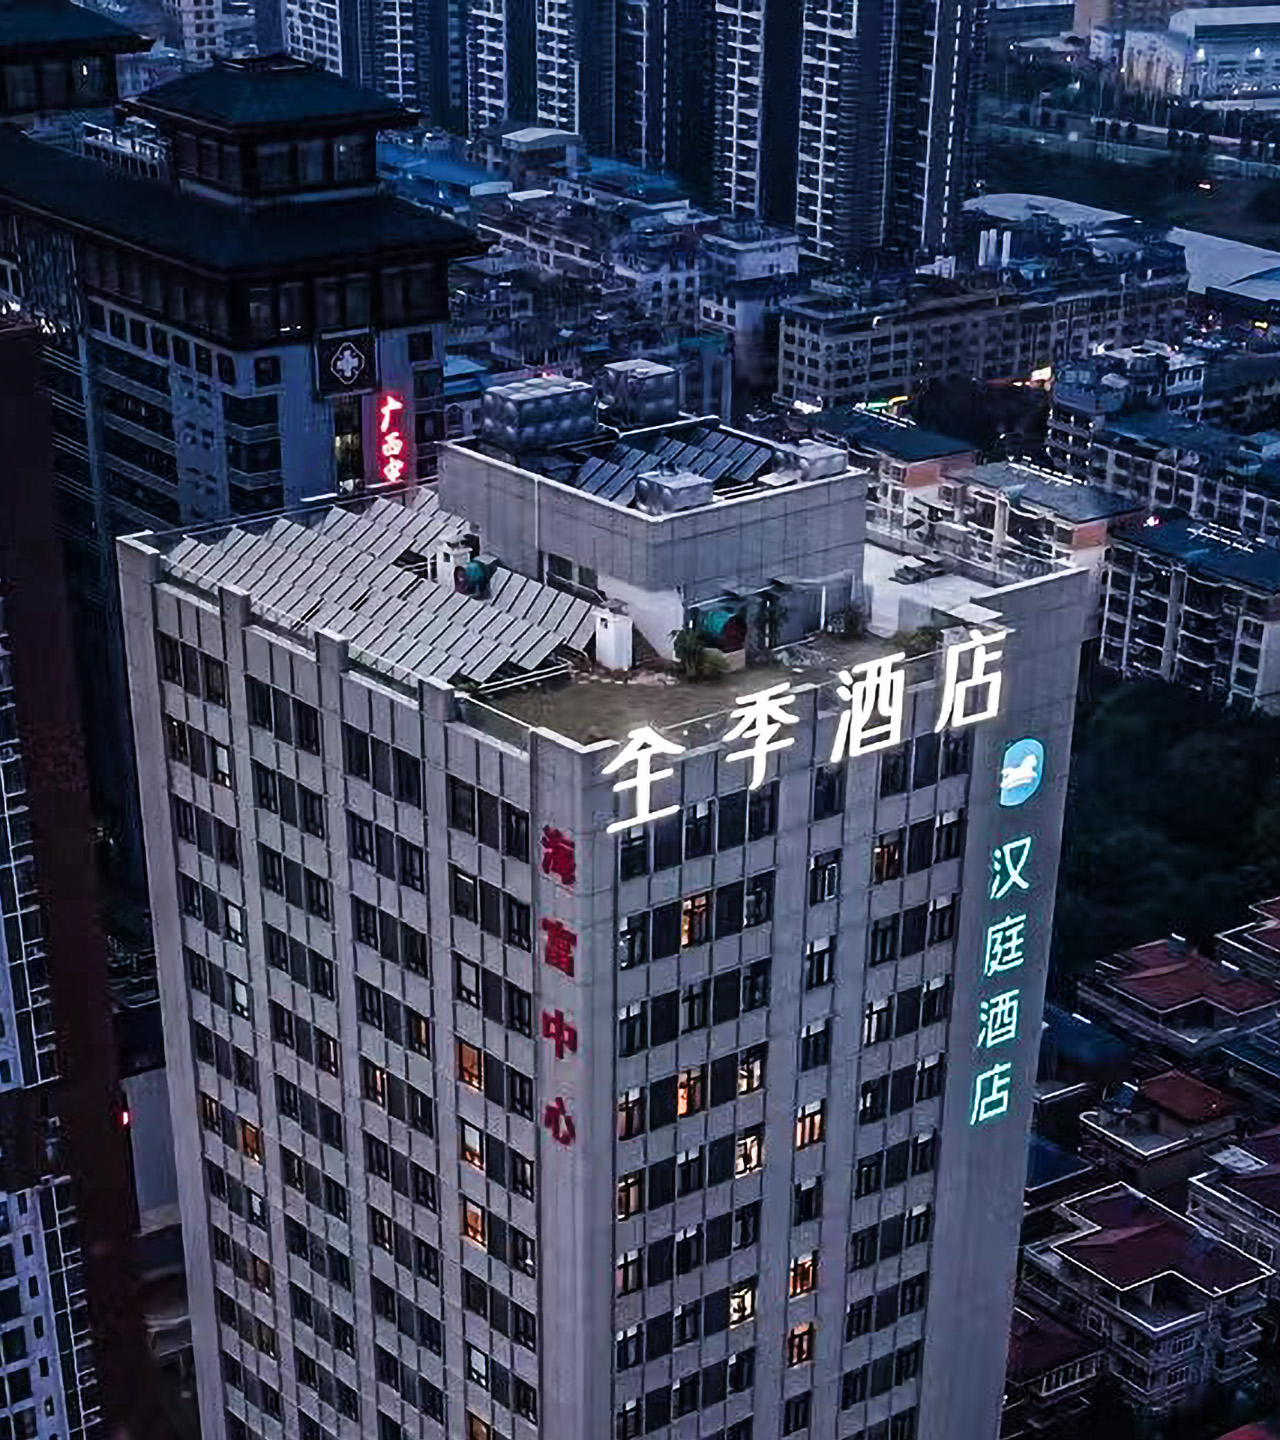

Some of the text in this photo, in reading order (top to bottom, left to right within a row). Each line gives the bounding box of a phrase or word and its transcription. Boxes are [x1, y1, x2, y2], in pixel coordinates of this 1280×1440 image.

[601, 629, 1007, 835] 全季酒店
[969, 836, 1032, 1126] 汉庭酒店
